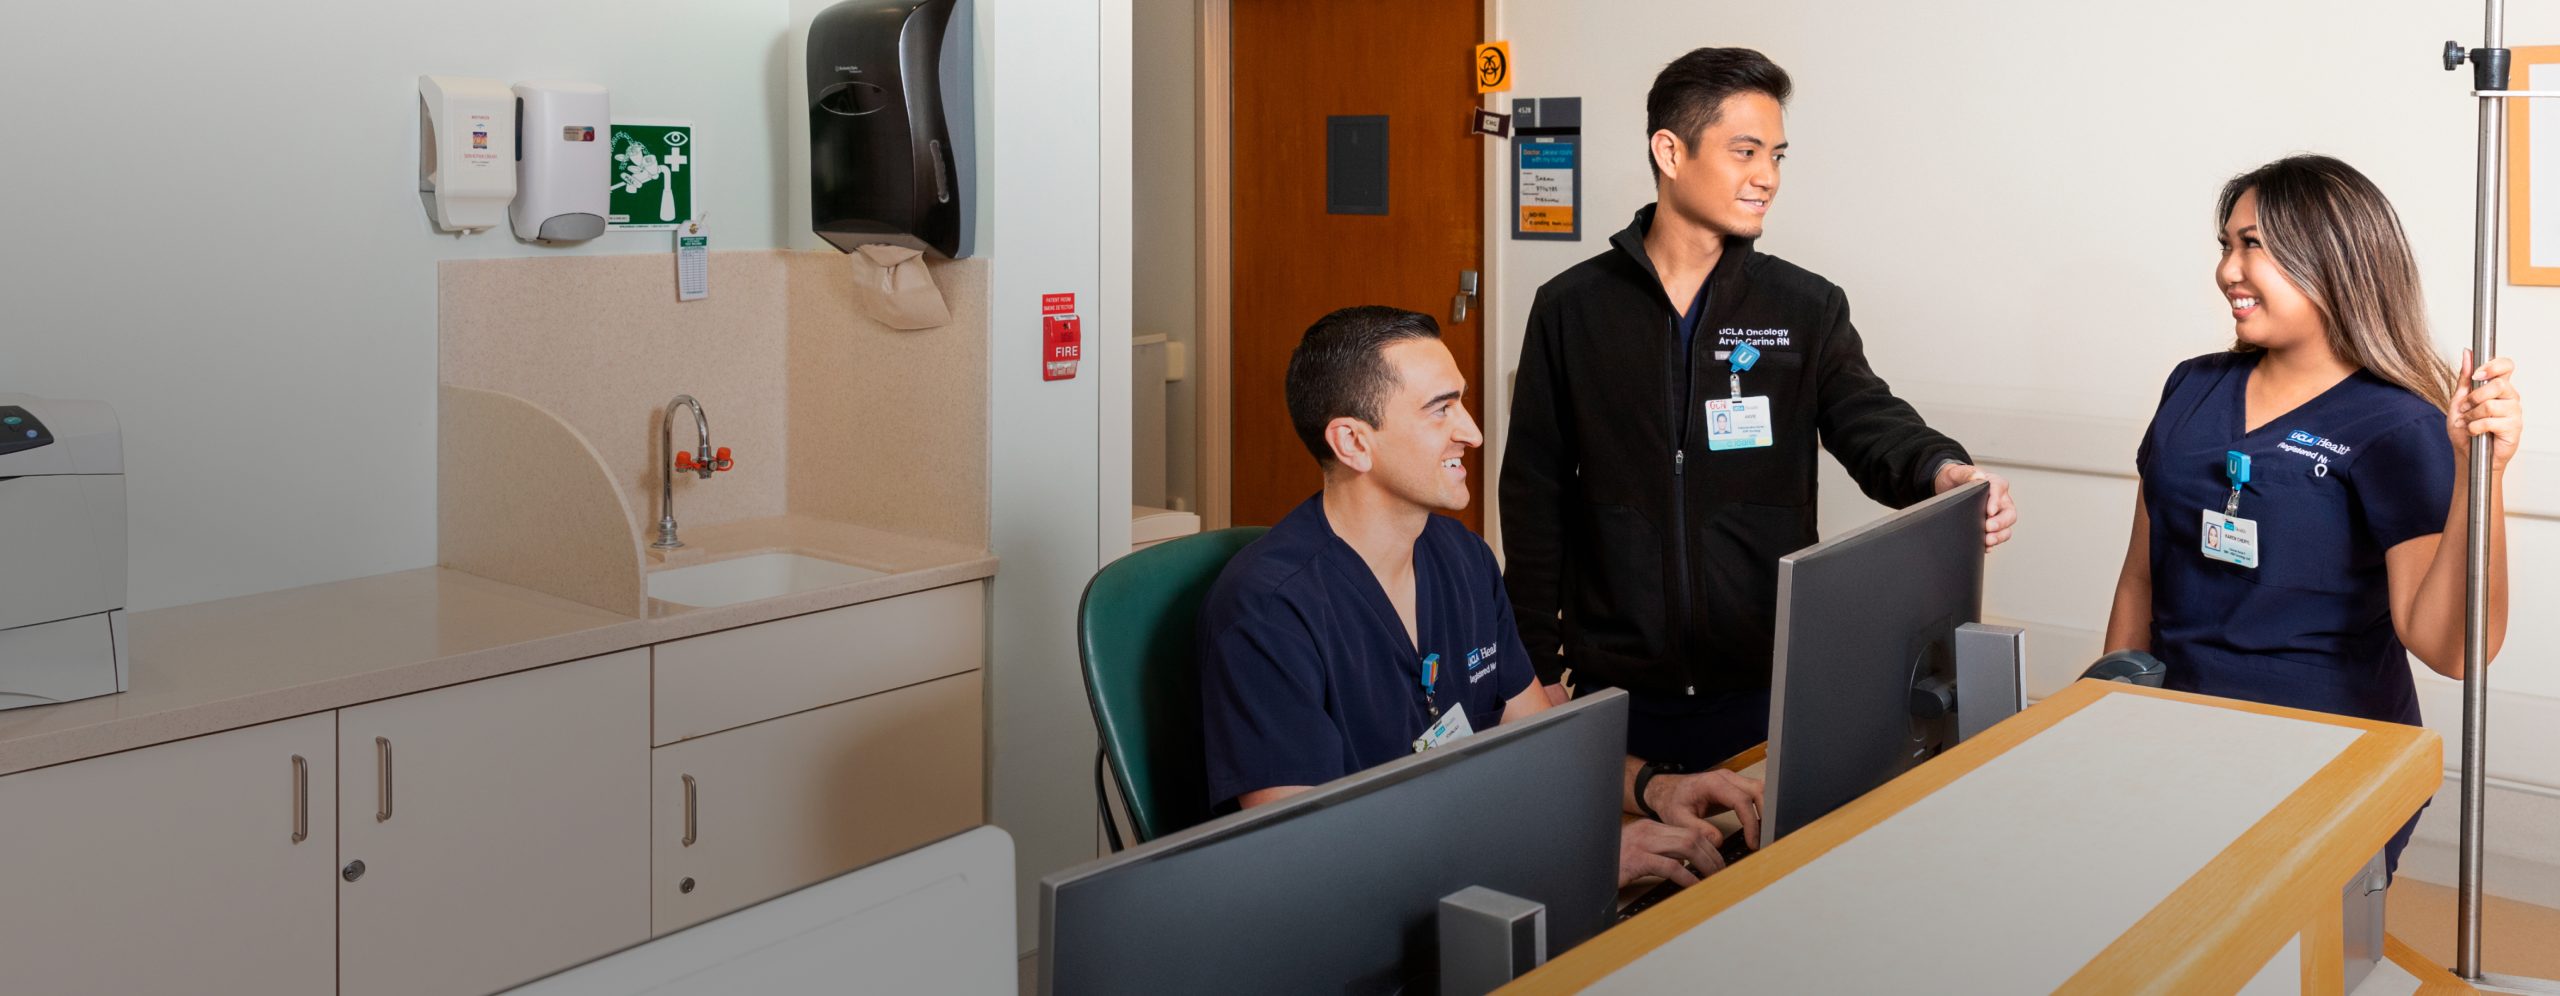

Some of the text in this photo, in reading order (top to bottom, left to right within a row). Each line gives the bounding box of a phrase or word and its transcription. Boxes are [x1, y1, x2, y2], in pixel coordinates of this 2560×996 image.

[1718, 327, 1789, 337] UCLA Oncology
[1745, 337, 1775, 346] Carino
[1776, 337, 1790, 346] RN
[1055, 345, 1078, 358] FIRE
[1738, 351, 1753, 364] U
[2290, 431, 2315, 444] UCLA
[2276, 441, 2319, 460] Registered
[2229, 459, 2238, 475] U
[1467, 642, 1497, 667] UCLA Heal
